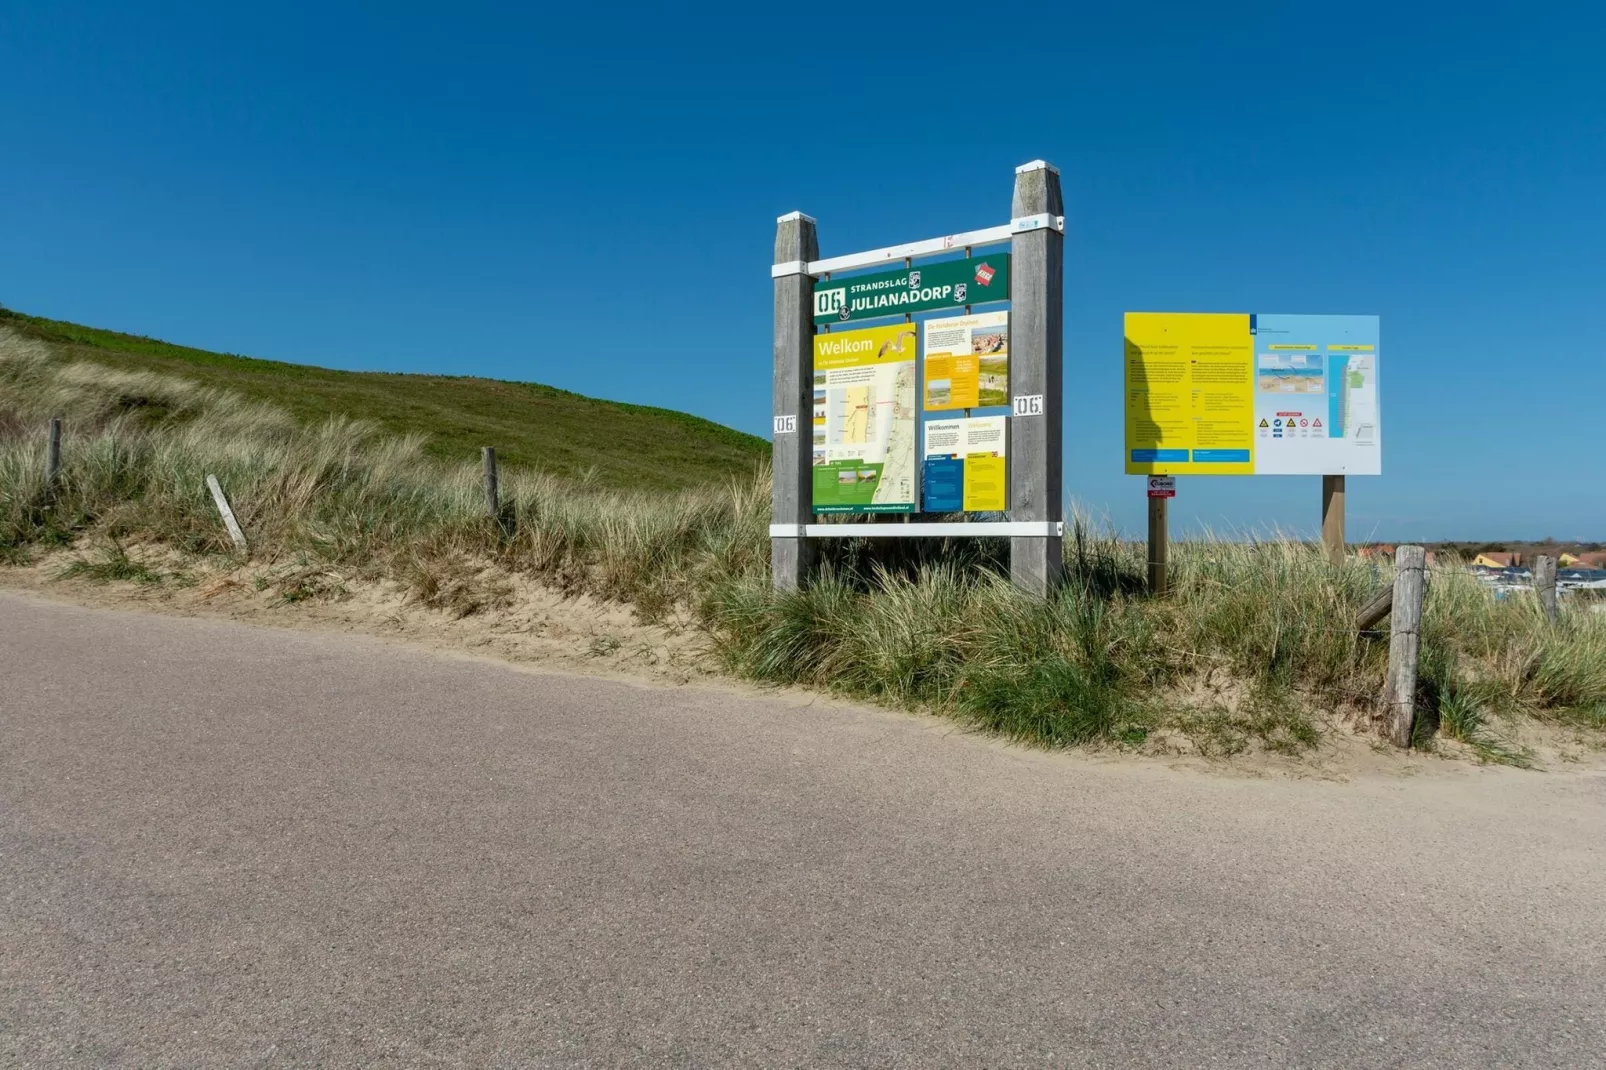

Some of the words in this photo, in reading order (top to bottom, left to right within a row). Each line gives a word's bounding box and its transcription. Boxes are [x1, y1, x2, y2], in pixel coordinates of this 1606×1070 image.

[850, 277, 908, 293] STRANDSLAG
[818, 291, 840, 312] 06
[850, 285, 952, 312] JULIANADORP
[818, 338, 873, 356] Welkom
[1018, 397, 1039, 414] 06
[777, 417, 793, 432] 06
